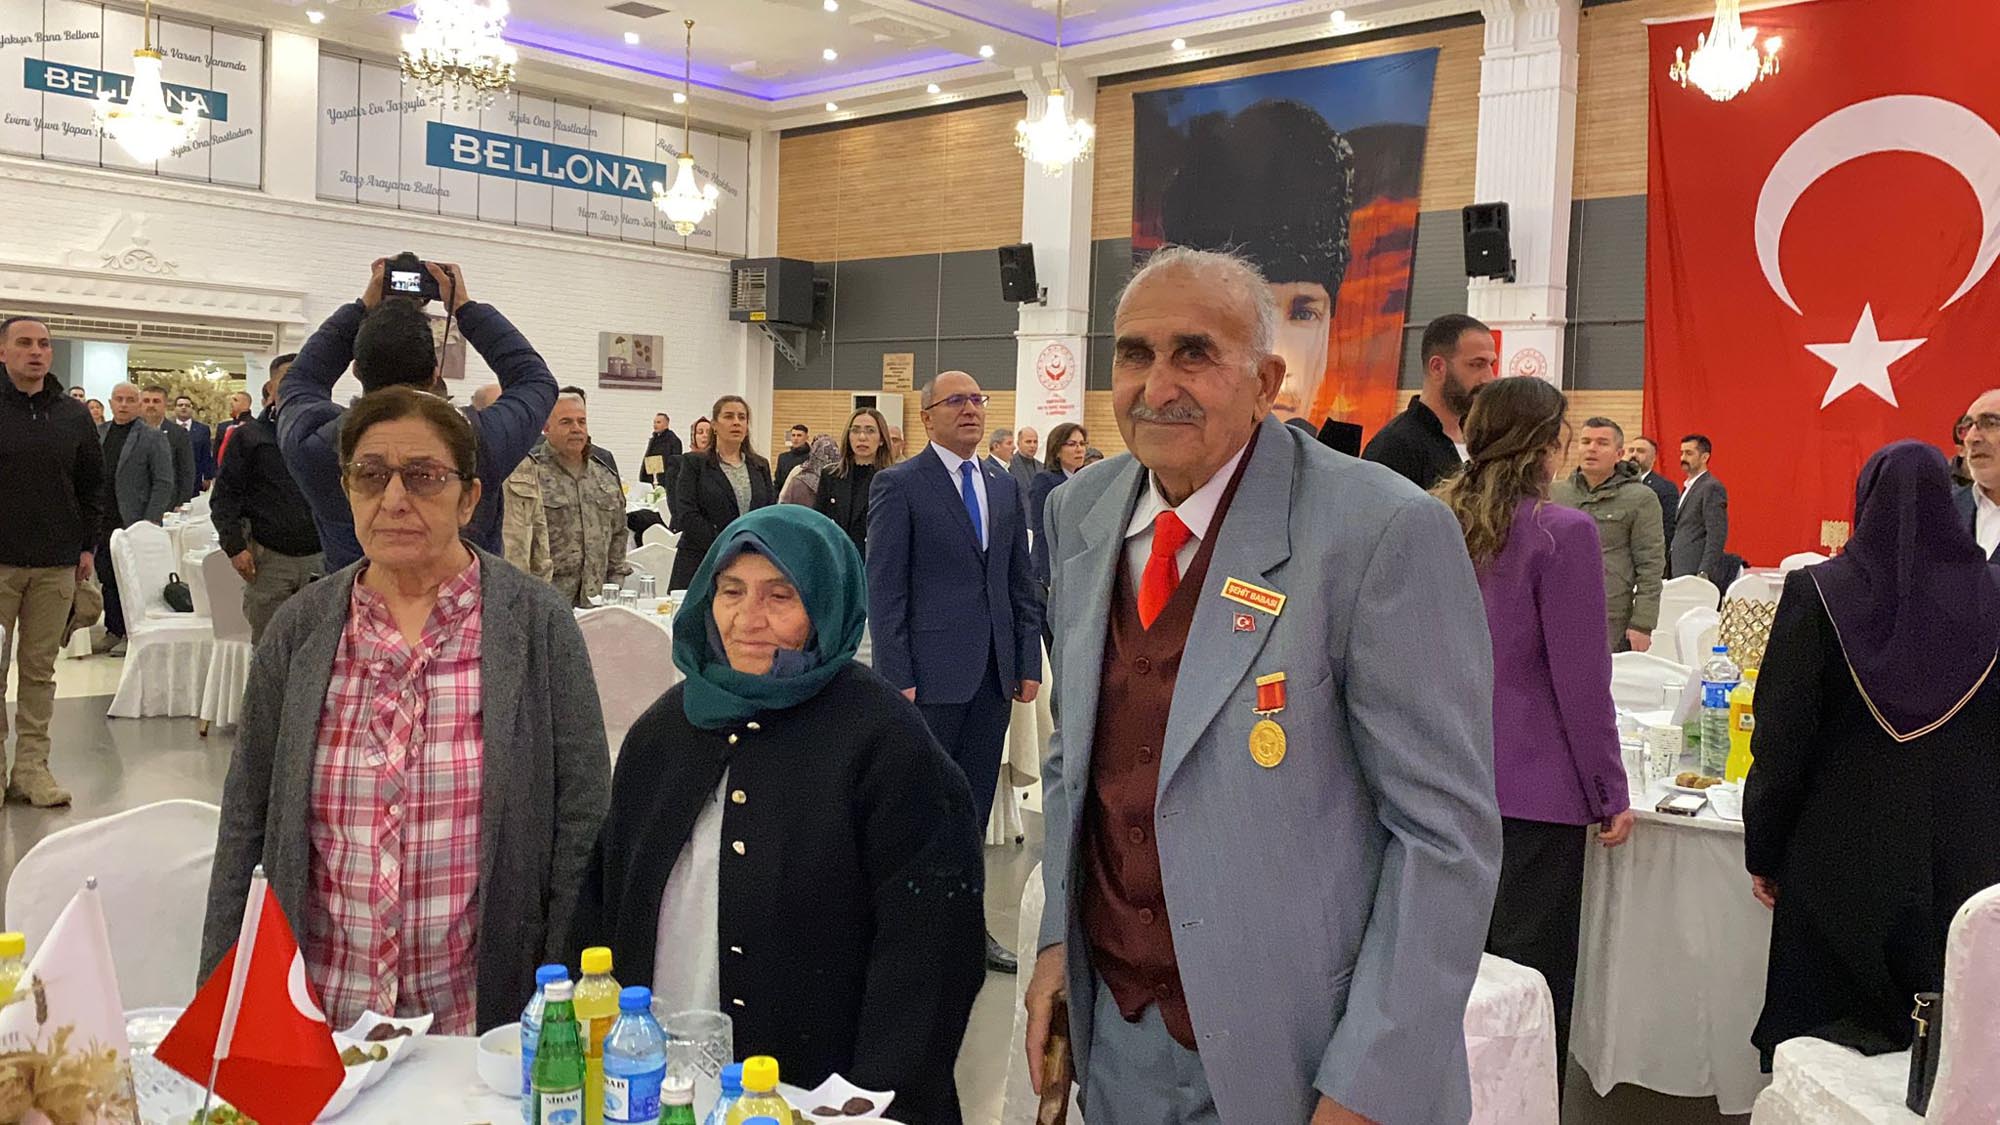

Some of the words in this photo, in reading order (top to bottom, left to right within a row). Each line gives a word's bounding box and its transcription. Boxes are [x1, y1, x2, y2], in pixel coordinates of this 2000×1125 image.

[63, 30, 100, 41] Bellona
[170, 47, 201, 63] Varsın
[203, 54, 247, 72] Yanımda
[44, 67, 210, 114] BELLNA
[33, 117, 60, 132] Yuva
[61, 121, 93, 137] Yapan
[532, 115, 551, 129] Ona
[192, 139, 211, 150] Ona
[450, 132, 647, 194] BELLONA
[413, 181, 451, 197] Bellona
